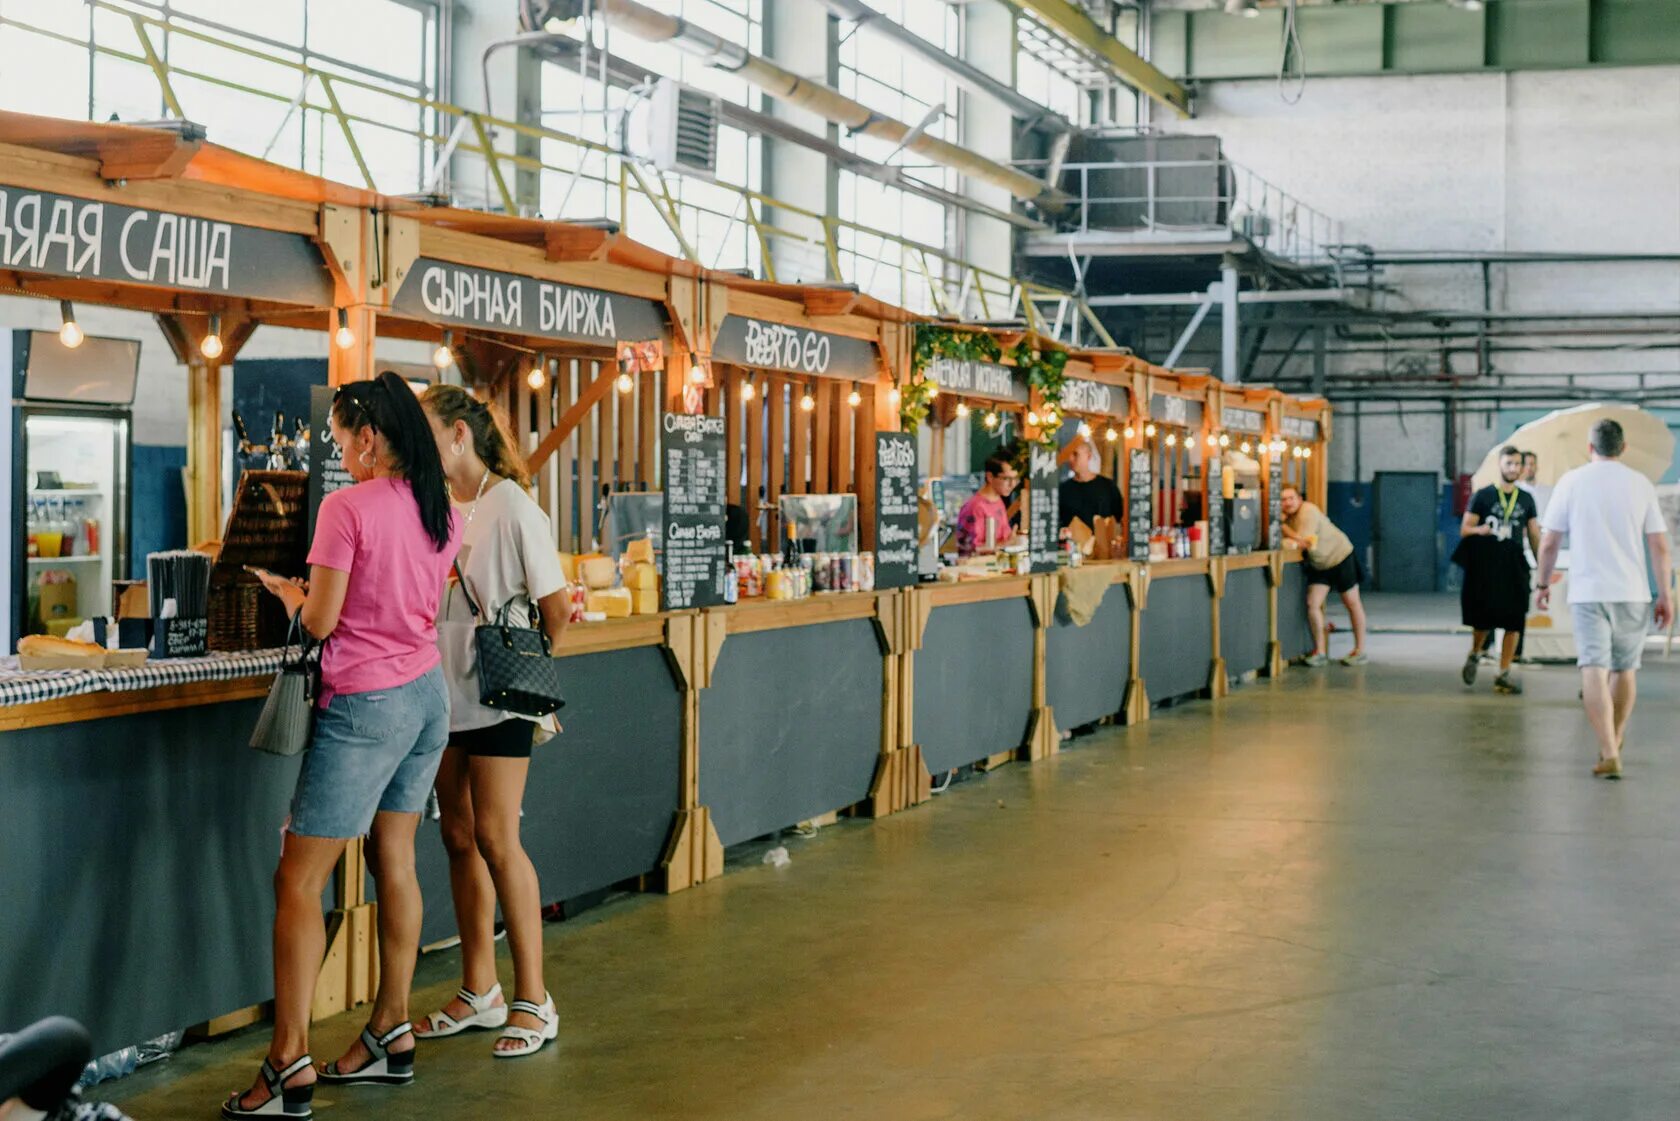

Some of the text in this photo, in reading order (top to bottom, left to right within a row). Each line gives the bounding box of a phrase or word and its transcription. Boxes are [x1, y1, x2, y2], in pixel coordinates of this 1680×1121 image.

[120, 210, 232, 290] САША
[421, 266, 616, 338] СЫРНАЯ БИРЖА
[745, 319, 831, 374] BEER TO GO
